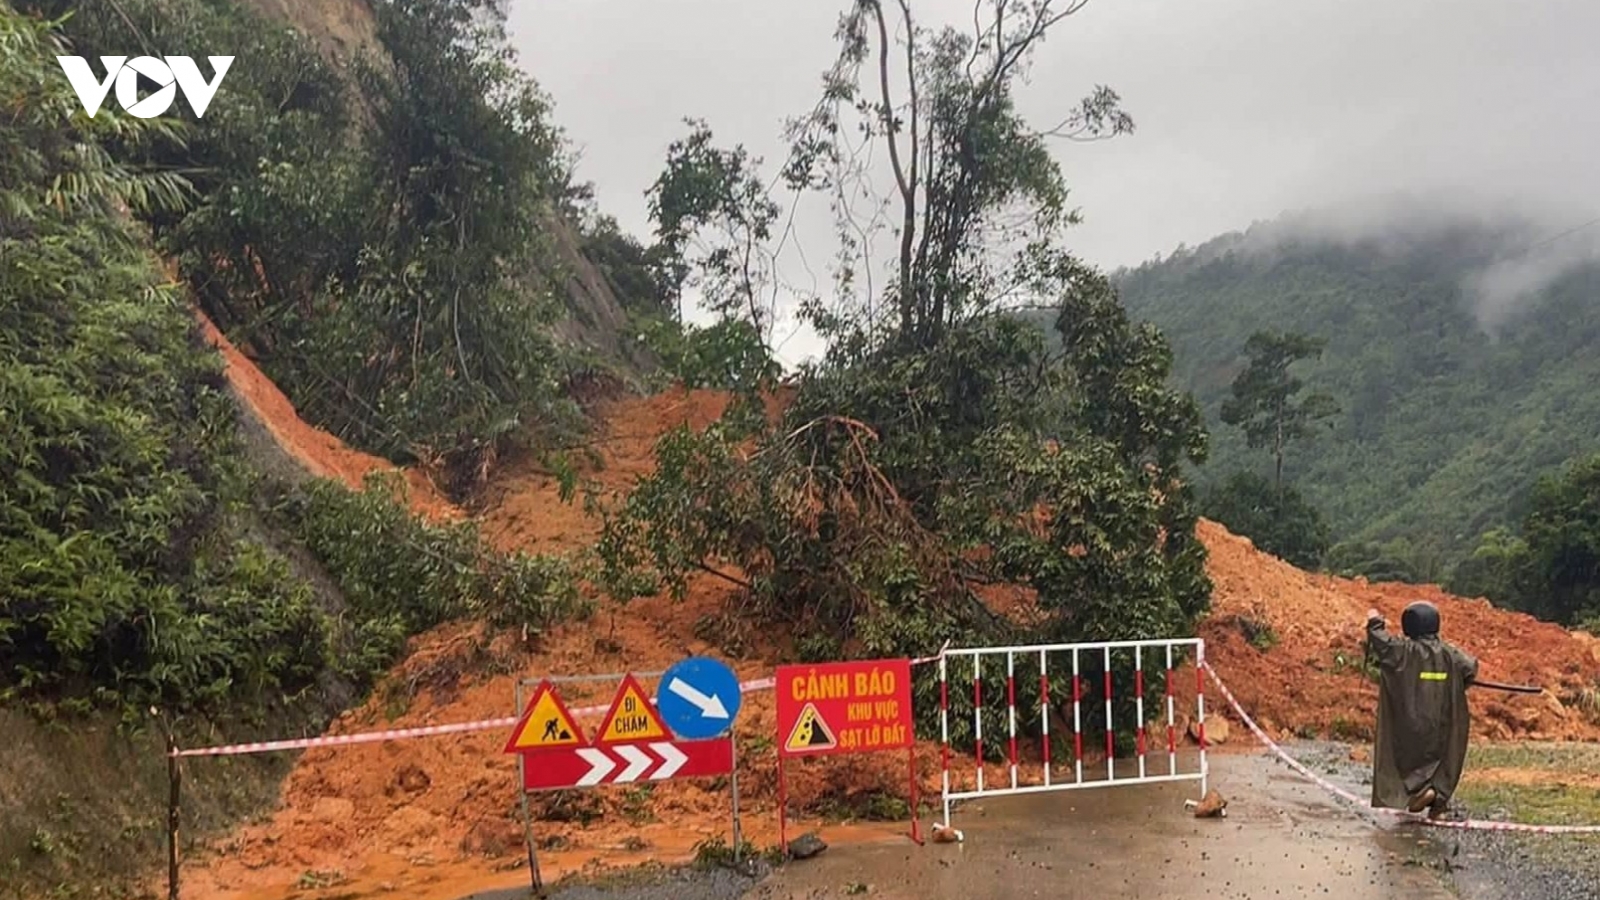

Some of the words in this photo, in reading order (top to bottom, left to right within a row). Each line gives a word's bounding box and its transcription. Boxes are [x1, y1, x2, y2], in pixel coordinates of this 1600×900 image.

[792, 668, 849, 702] CẢNH
[855, 667, 896, 697] BÁO
[624, 696, 637, 712] ĐI
[847, 701, 872, 722] KHU
[875, 699, 899, 723] VỰC
[839, 728, 863, 750] SẠT
[882, 721, 906, 745] ĐẤT
